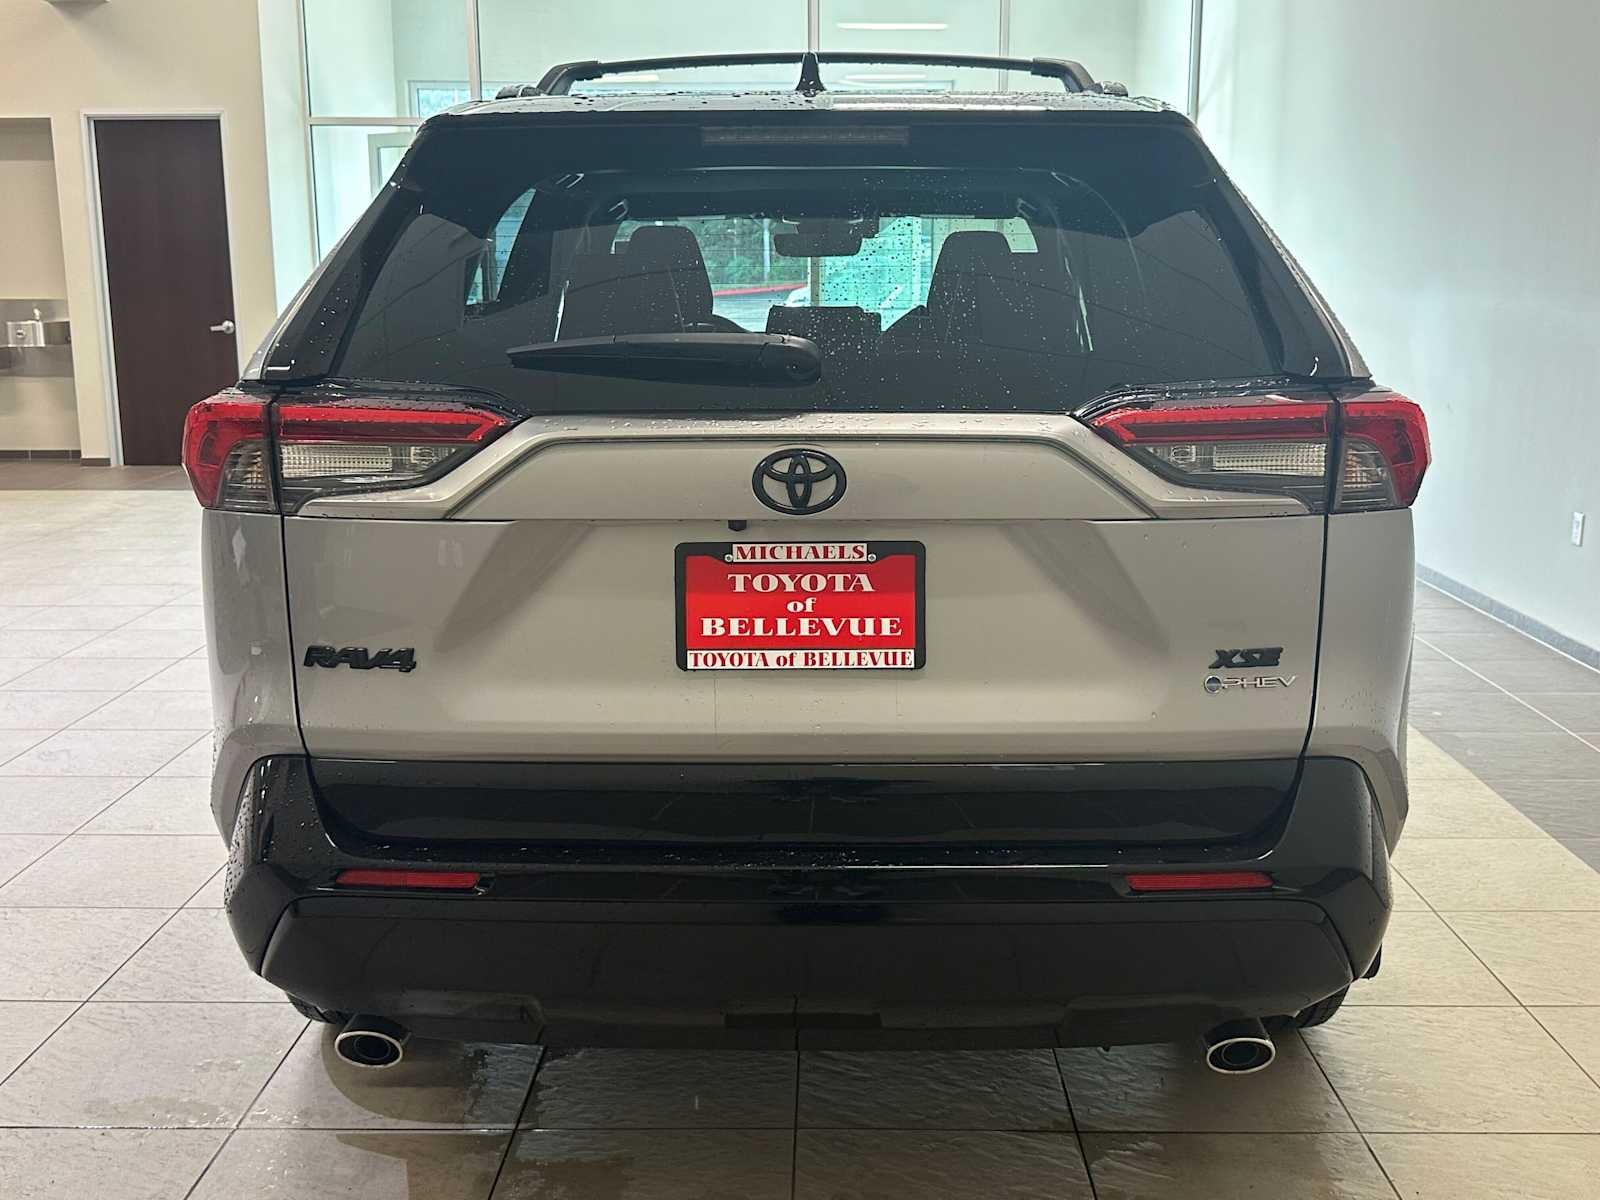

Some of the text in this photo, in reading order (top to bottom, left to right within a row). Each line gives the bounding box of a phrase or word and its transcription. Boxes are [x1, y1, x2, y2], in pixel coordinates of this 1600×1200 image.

[736, 544, 865, 560] MICHAELS
[728, 573, 875, 592] TOYOTA
[786, 597, 817, 613] of
[700, 617, 902, 637] BELLEVUE
[304, 645, 417, 673] RAV4
[689, 651, 913, 667] TOYOTA of BELLEVUE
[1208, 647, 1284, 669] XSE
